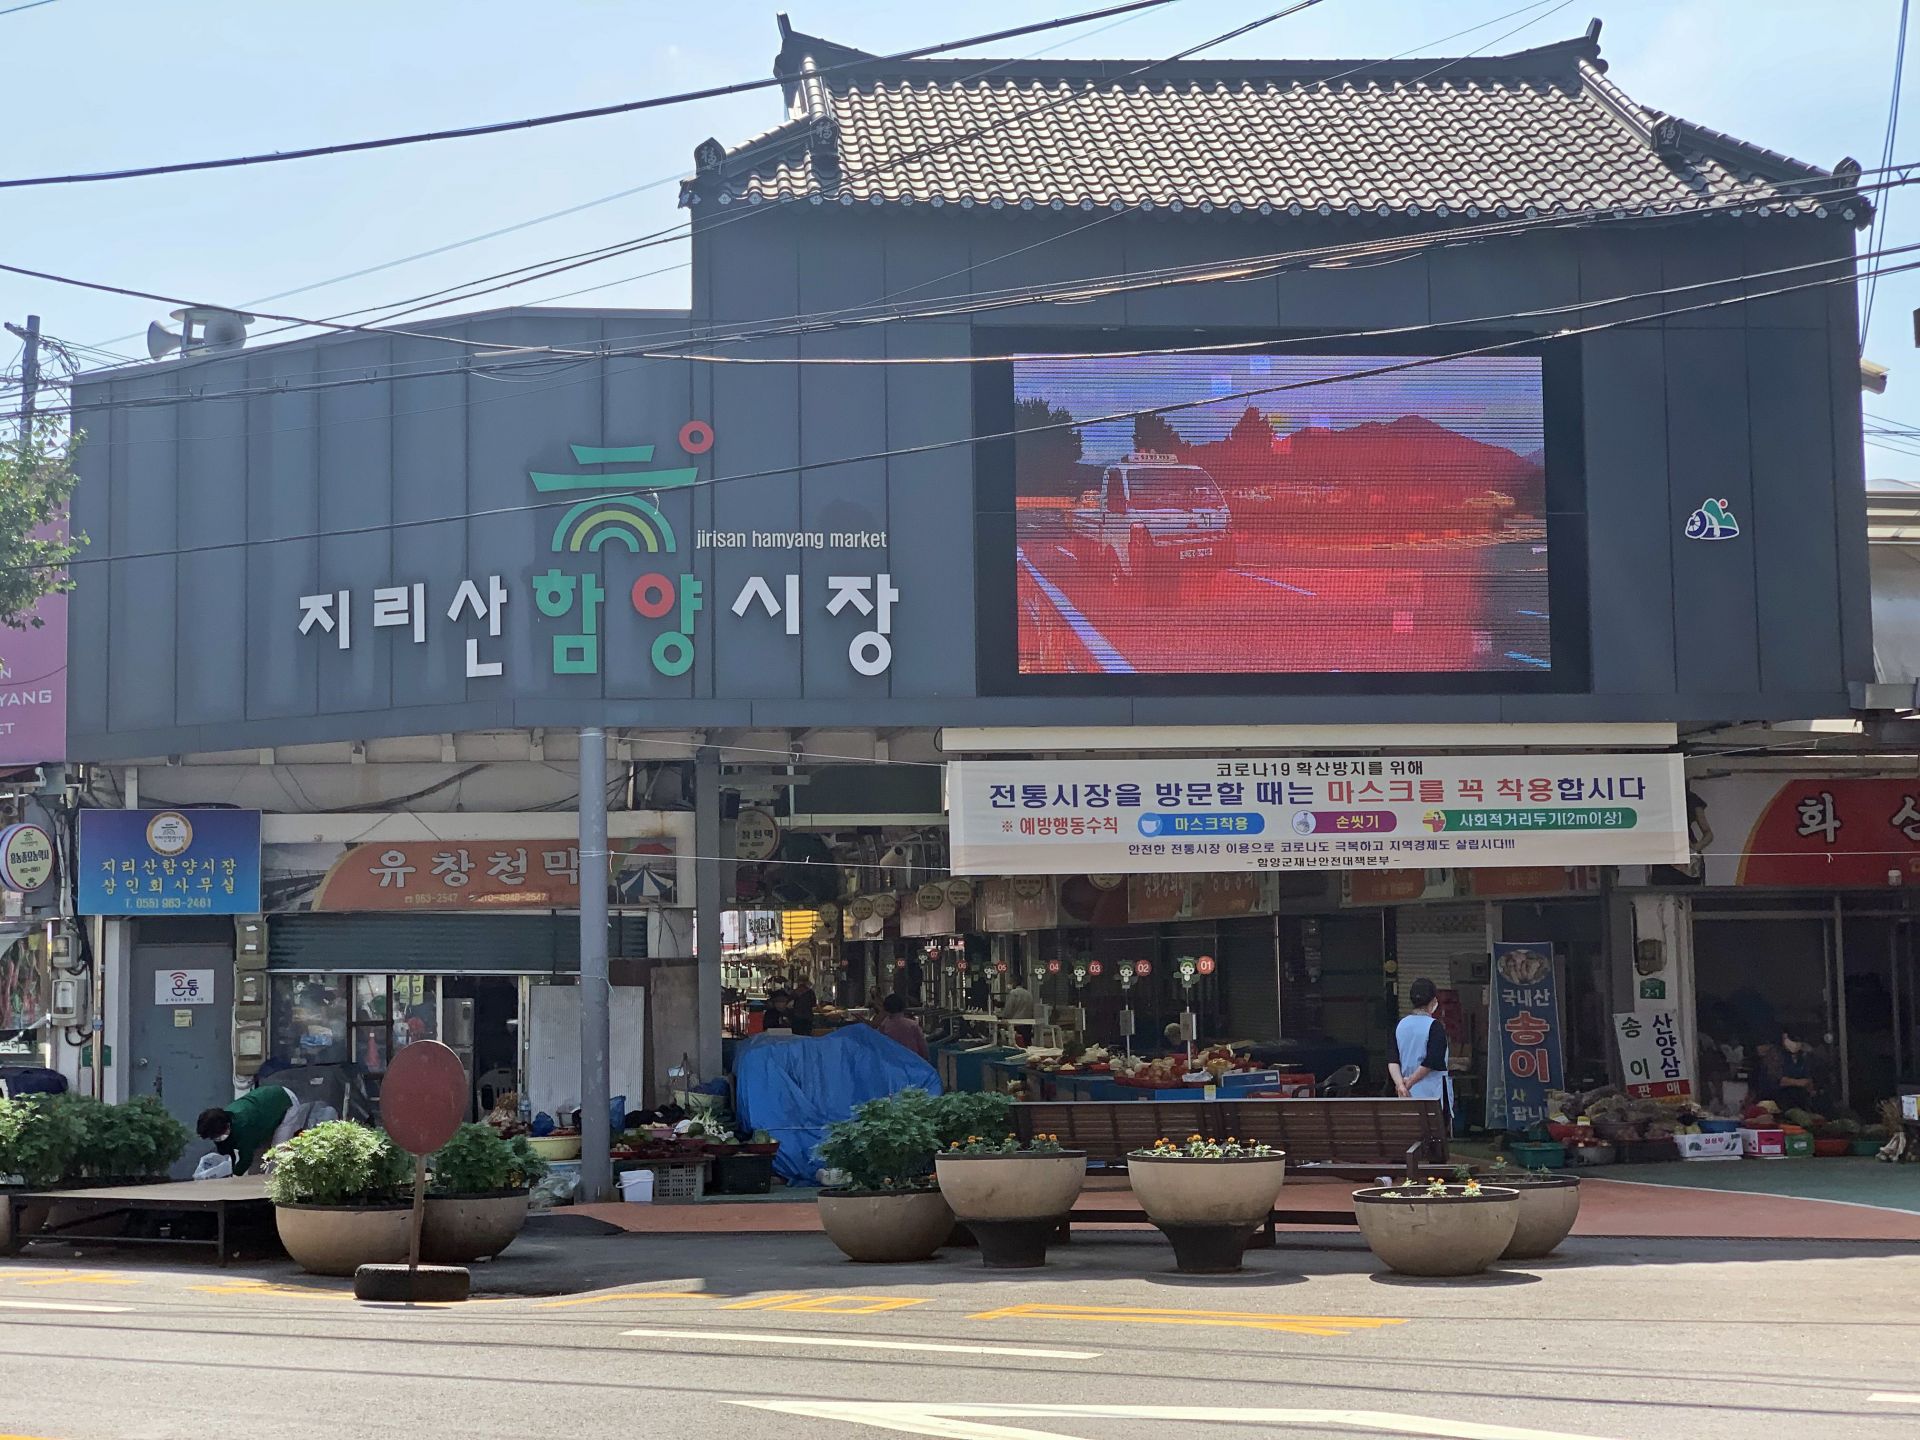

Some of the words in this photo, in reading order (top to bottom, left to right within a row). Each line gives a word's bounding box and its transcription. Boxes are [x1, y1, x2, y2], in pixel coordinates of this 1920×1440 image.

[696, 530, 746, 549] jirisan
[752, 530, 824, 549] hamyang
[829, 530, 887, 548] market
[1216, 763, 1290, 777] 코로나19
[1296, 761, 1383, 777] 확산방지를
[1390, 760, 1424, 776] 위해
[989, 783, 1142, 809] 전통시장을
[1156, 782, 1244, 808] 방문할
[1256, 781, 1313, 806] 때는
[1327, 779, 1445, 804] 마스크를
[1457, 778, 1484, 803] 꼭
[1496, 776, 1646, 803] 착용합시다
[1019, 816, 1119, 836] 예방행동수칙
[1175, 816, 1249, 832] 마스크착용
[1335, 814, 1380, 830] 손씻기
[1128, 844, 1165, 856] 안전한
[1171, 843, 1220, 856] 전통시장
[1226, 842, 1275, 854] 이용으로
[1280, 841, 1329, 853] 코로나도
[1335, 840, 1384, 852] 극복하고
[1389, 839, 1450, 851] 지역경제도
[1455, 838, 1516, 851] 살립시다!!!
[1502, 988, 1551, 1007] 국내산
[1645, 989, 1660, 997] 2-1
[1504, 1010, 1551, 1083] 송이
[1652, 1012, 1681, 1079] 산양삼
